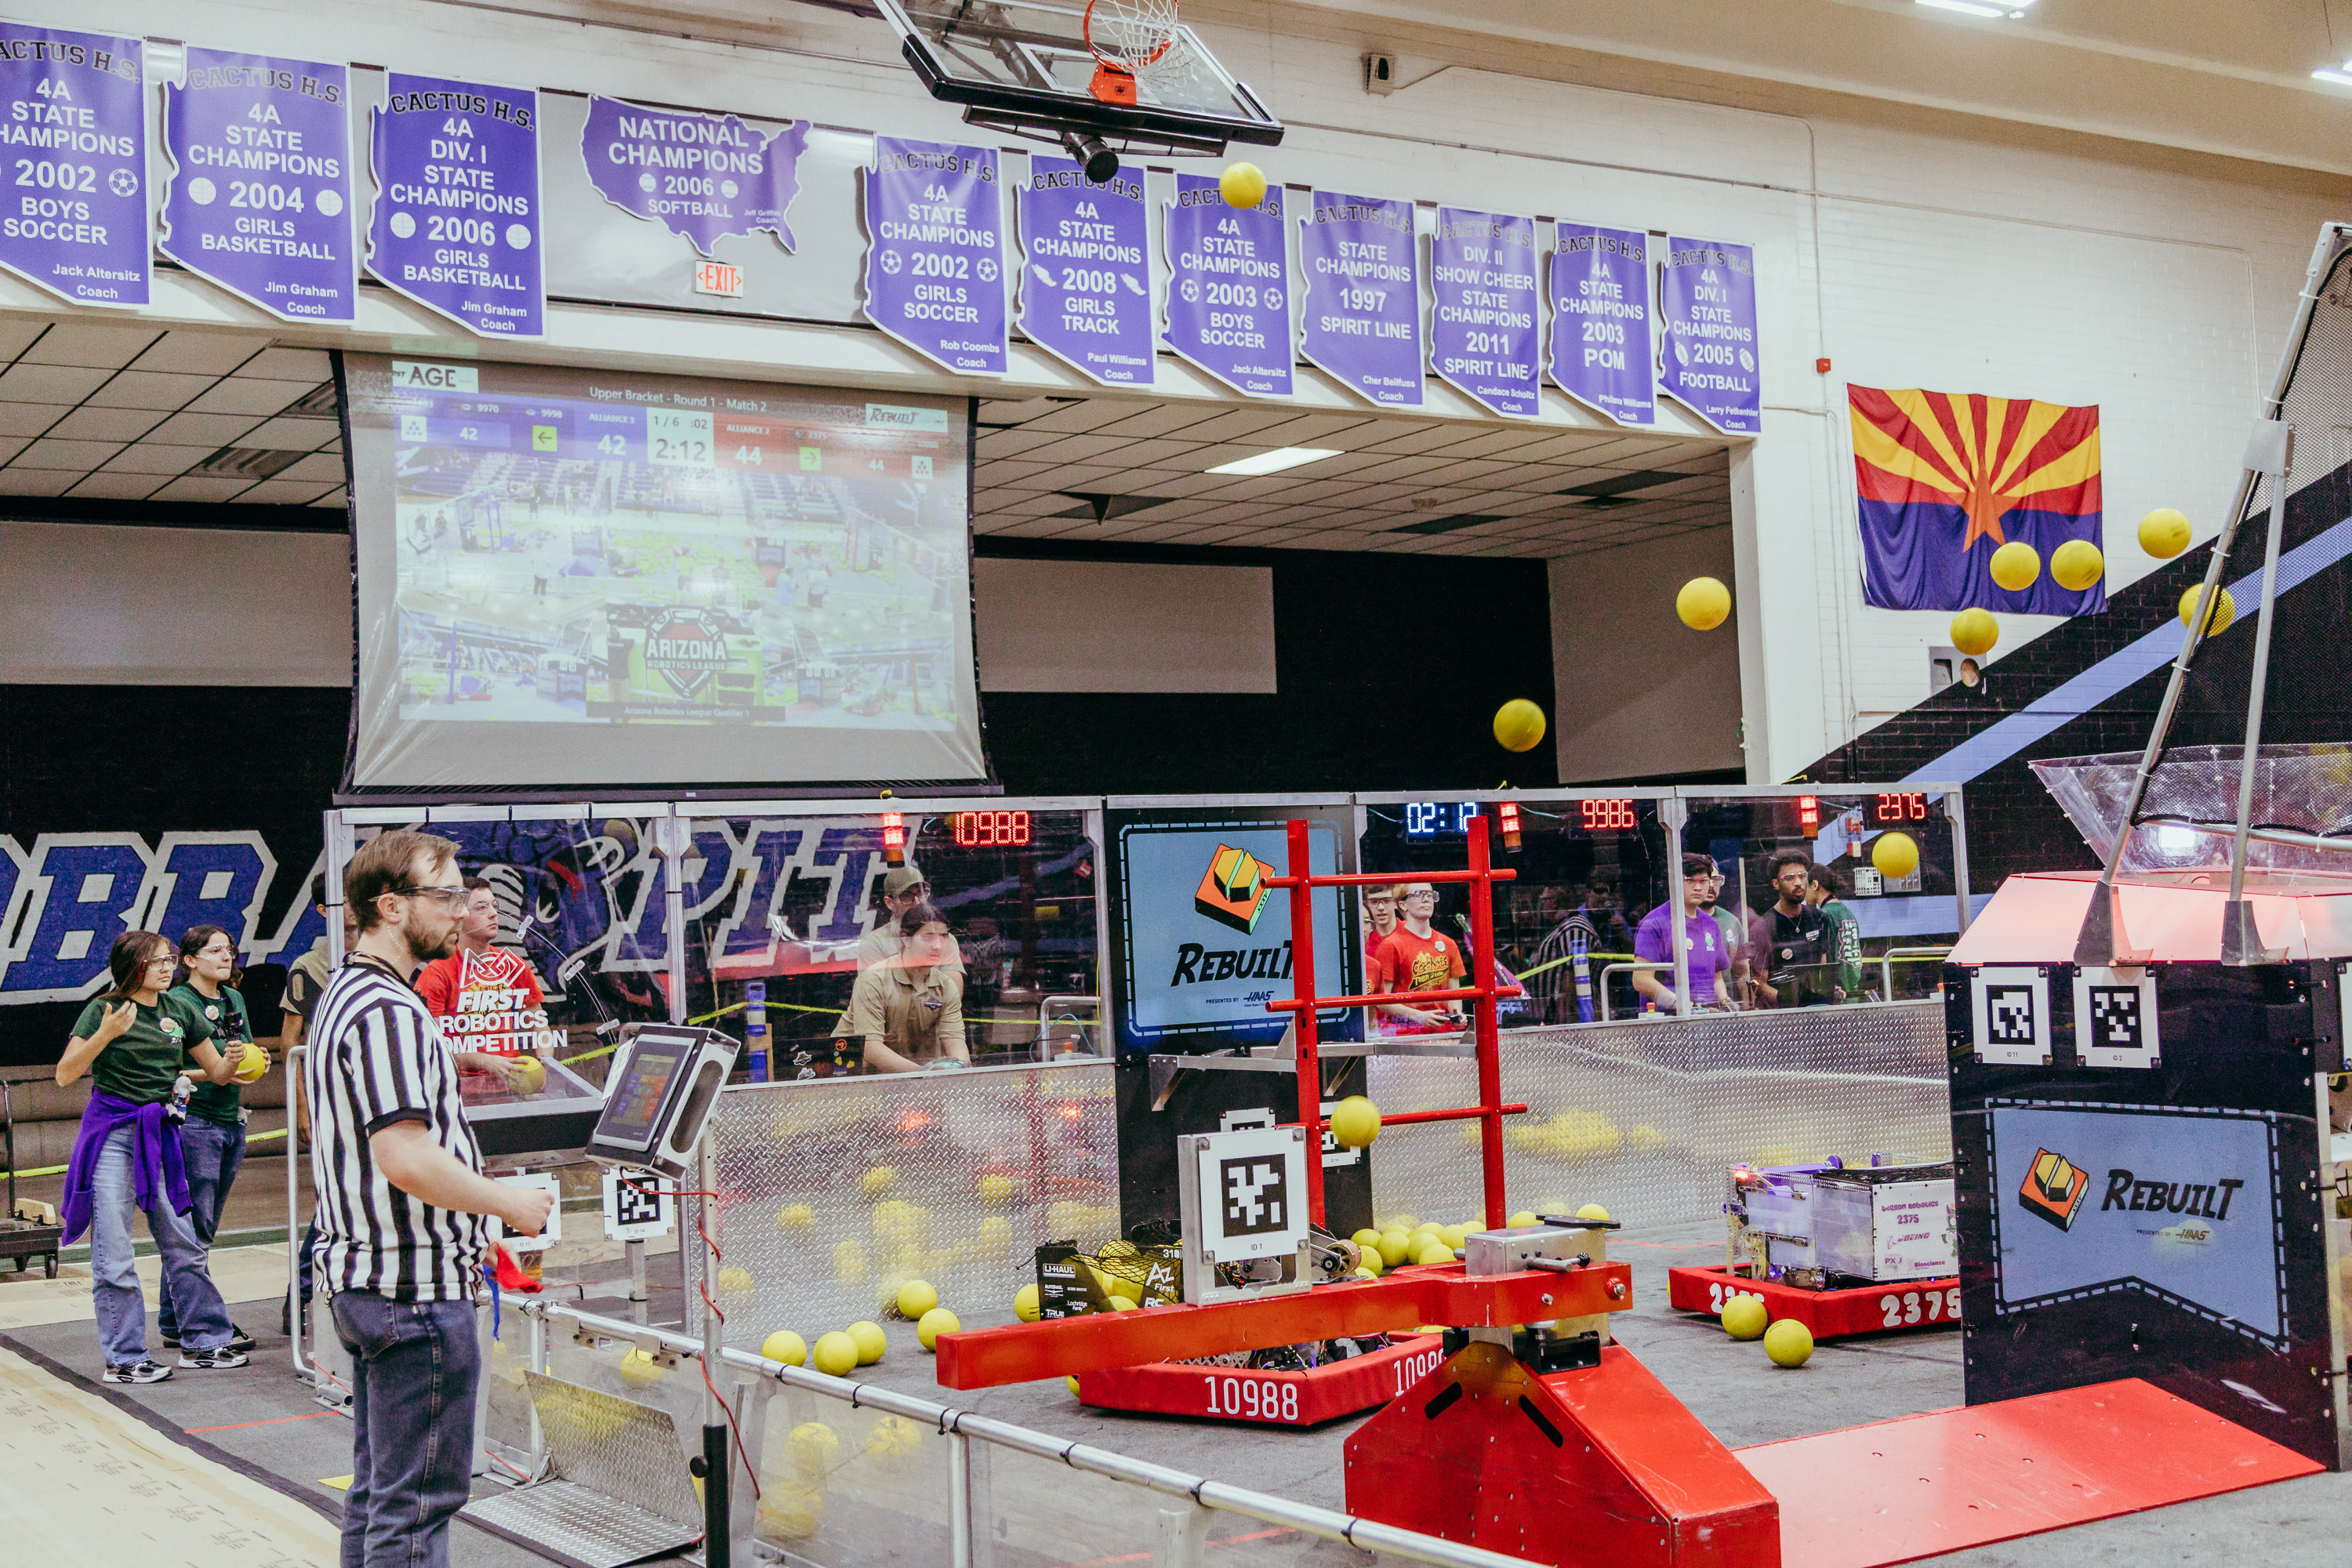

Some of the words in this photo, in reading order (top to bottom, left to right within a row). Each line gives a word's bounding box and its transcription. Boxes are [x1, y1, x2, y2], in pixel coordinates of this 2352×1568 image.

[36, 78, 71, 100] 4A
[189, 66, 292, 91] CACTUS
[301, 78, 343, 106] H.S.
[12, 101, 95, 129] STATE
[249, 103, 281, 124] 4A
[391, 92, 485, 114] CACTUS
[492, 100, 534, 130] H.S.
[225, 126, 303, 151] STATE
[443, 118, 474, 139] 4A
[619, 117, 749, 147] NATIONAL
[188, 146, 339, 178] CHAMPIONS
[430, 140, 474, 160] DIV.
[480, 147, 486, 163] I
[608, 142, 763, 174] CHAMPIONS
[16, 159, 96, 193] 2002
[424, 165, 494, 190] STATE
[665, 176, 714, 197] 2006
[230, 182, 304, 212] 2004
[391, 184, 528, 215] CHAMPIONS
[21, 198, 89, 220] BOYS
[648, 199, 732, 218] SOFTBALL
[908, 204, 966, 224] STATE
[3, 218, 107, 245] SOCCER
[235, 217, 295, 237] GIRLS
[428, 216, 495, 246] 2006
[880, 222, 995, 248] CHAMPIONS
[1059, 221, 1115, 241] STATE
[201, 234, 336, 260] BASKETBALL
[1033, 239, 1142, 264] CHAMPIONS
[1203, 237, 1254, 257] STATE
[1338, 241, 1388, 261] STATE
[1464, 247, 1491, 264] DIV.
[1559, 236, 1616, 254] CACTUS
[1621, 243, 1646, 264] H.S.
[435, 249, 489, 268] GIRLS
[911, 252, 968, 279] 2002
[1180, 253, 1280, 278] CHAMPIONS
[53, 263, 86, 278] Jack
[89, 267, 140, 281] Altersitz
[404, 264, 526, 290] BASKETBALL
[706, 264, 736, 292] EXIT
[1062, 268, 1117, 293] 2008
[1316, 258, 1411, 282] CHAMPIONS
[1436, 267, 1479, 285] SHOW
[1483, 272, 1534, 291] CHEER
[77, 285, 118, 299] Coach
[265, 282, 288, 295] Jim
[291, 285, 338, 298] Graham
[914, 285, 967, 303] GIRLS
[1207, 283, 1257, 307] 2003
[1340, 288, 1387, 312] 1997
[1462, 290, 1508, 309] STATE
[1580, 280, 1623, 299] STATE
[1694, 285, 1719, 302] DIV.
[287, 301, 325, 315] Coach
[461, 301, 482, 313] Jim
[485, 303, 527, 317] Graham
[904, 302, 978, 323] SOCCER
[1065, 297, 1115, 315] GIRLS
[1559, 296, 1644, 321] CHAMPIONS
[1691, 305, 1731, 323] STATE
[481, 318, 515, 331] Coach
[1062, 314, 1120, 335] TRACK
[1210, 312, 1254, 331] BOYS
[1321, 316, 1371, 336] SPIRIT
[1376, 321, 1411, 339] LINE
[1440, 307, 1531, 329] CHAMPIONS
[1200, 329, 1265, 349] SOCCER
[1582, 321, 1624, 345] 2003
[1673, 320, 1751, 342] CHAMPIONS
[941, 339, 960, 350] Rob
[961, 341, 1000, 353] Coombs
[1465, 332, 1509, 354] 2011
[957, 357, 986, 368] Coach
[1087, 353, 1107, 363] Paul
[1109, 354, 1147, 365] Williams
[1584, 348, 1625, 371] POM
[1693, 343, 1734, 365] 2005
[1105, 369, 1133, 379] Coach
[1232, 364, 1252, 375] Jack
[1254, 366, 1287, 378] Altersitz
[1444, 358, 1493, 376] SPIRIT
[1497, 362, 1529, 380] LINE
[1247, 380, 1272, 391] Coach
[1477, 386, 1508, 398] Candace
[1679, 372, 1751, 393] FOOTBALL
[590, 387, 622, 402] Upper
[625, 390, 663, 403] Bracket
[674, 394, 707, 407] Round
[711, 397, 716, 408] 1
[727, 398, 757, 412] Match
[760, 401, 767, 412] 2
[1379, 391, 1403, 401] Coach
[1502, 401, 1522, 412] Coach
[1623, 397, 1652, 408] Williams
[589, 412, 628, 423] ALLIANCE
[1619, 411, 1637, 421] Coach
[1706, 405, 1725, 416] Larry
[727, 424, 761, 435] ALLIANCE
[1726, 419, 1746, 430] Coach
[597, 434, 626, 456] 42
[655, 438, 706, 462] 2:12
[735, 445, 762, 466] 44
[647, 639, 726, 659] ARIZONA
[648, 660, 691, 670] ROBOTICS
[693, 662, 726, 670] LEAGUE
[686, 709, 712, 717] League
[1582, 799, 1634, 828] 9986
[1878, 793, 1925, 819] 2375
[956, 811, 1029, 845] 10988
[456, 989, 529, 1012] FIRST
[1243, 991, 1274, 1002] HAAS
[439, 1010, 549, 1034] ROBOTICS
[2101, 1169, 2244, 1221] REBUILT
[1897, 1214, 1919, 1225] 2375
[2176, 1229, 2209, 1241] HAAS
[1044, 1265, 1075, 1273] U-HAUL
[1045, 1308, 1065, 1317] TRUE
[1881, 1288, 1961, 1327] 2375
[1204, 1375, 1299, 1421] 10988
